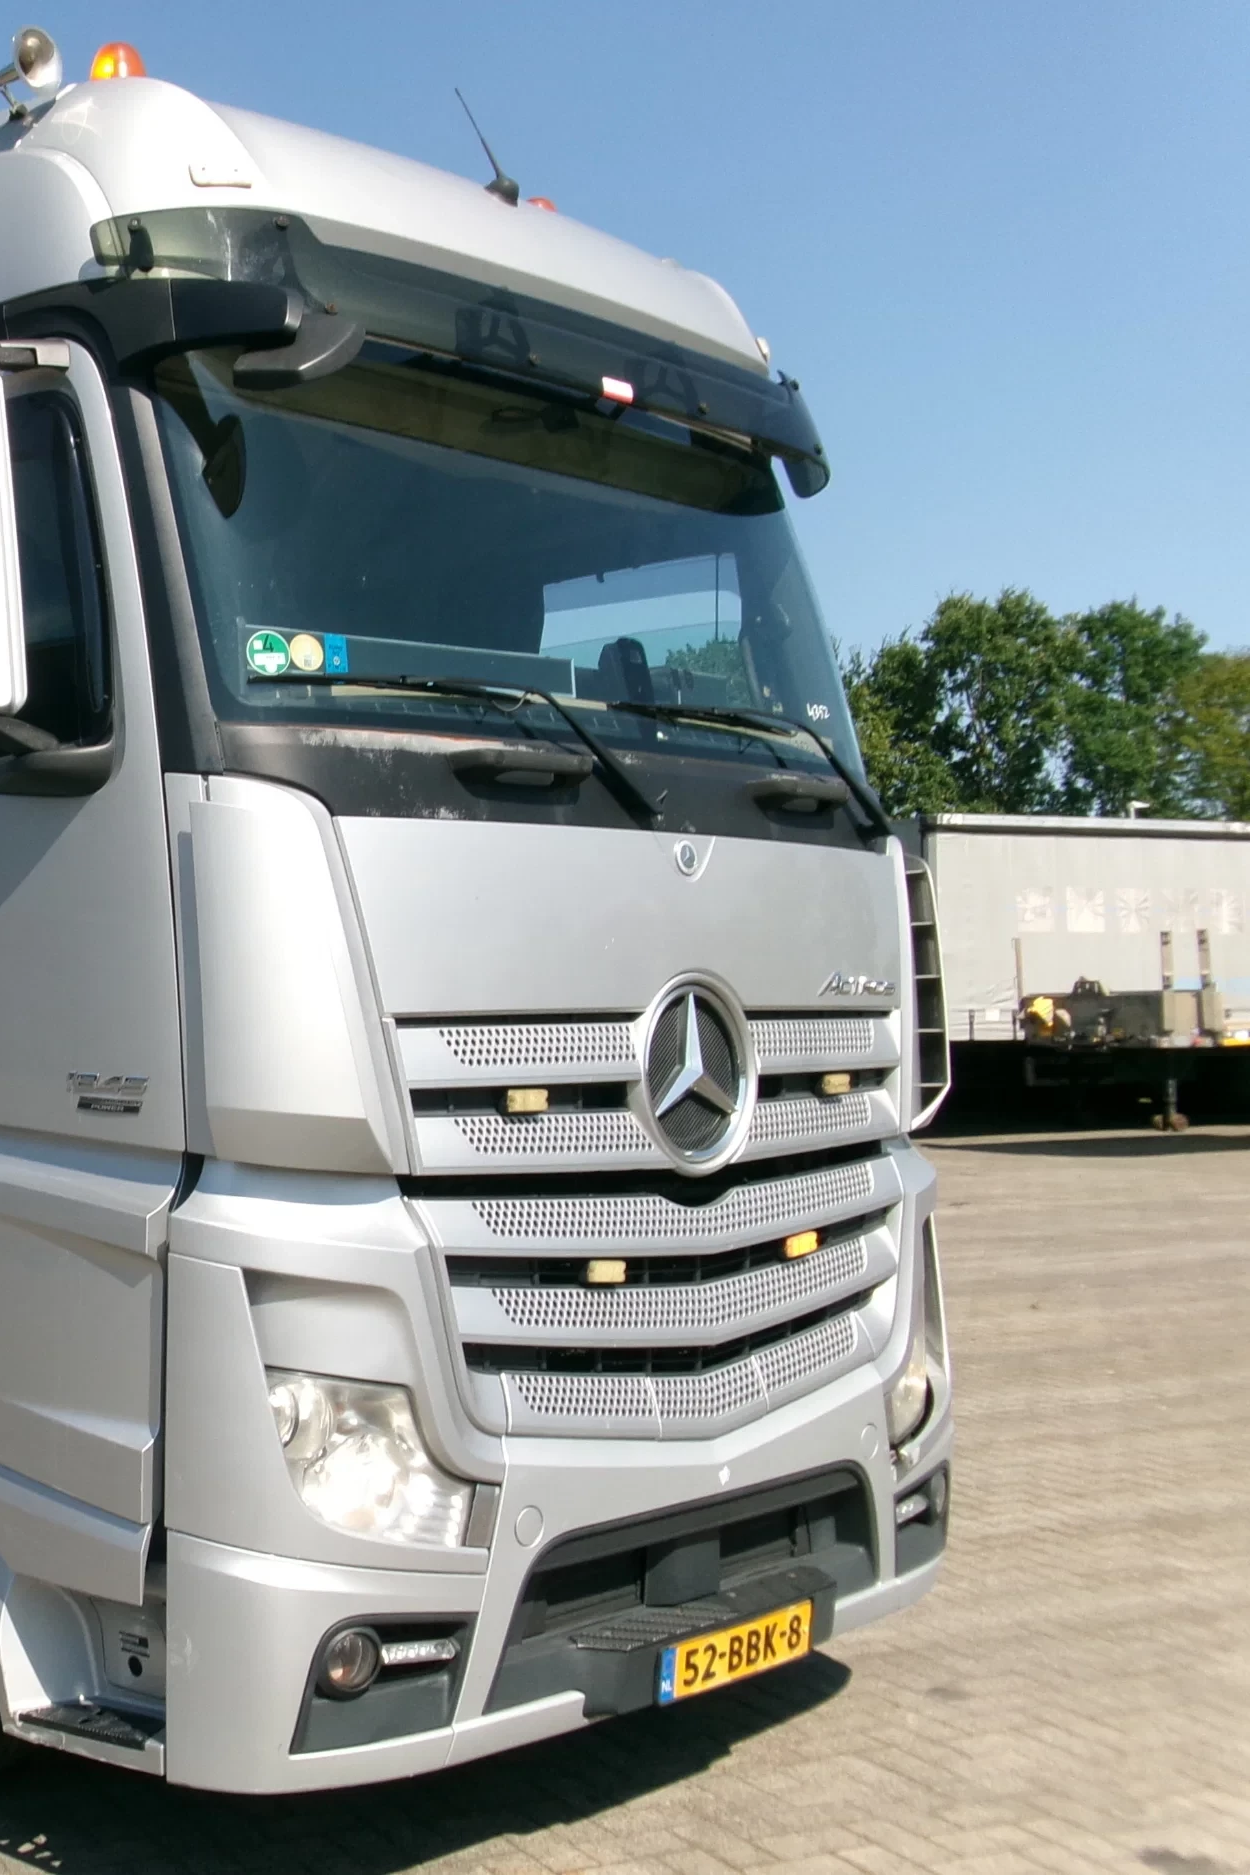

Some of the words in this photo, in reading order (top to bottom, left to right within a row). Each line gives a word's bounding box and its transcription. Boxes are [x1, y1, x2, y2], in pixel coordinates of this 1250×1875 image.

[262, 634, 274, 652] 4
[91, 1103, 124, 1113] POWER
[683, 1615, 801, 1688] 52-BBK-8
[661, 1680, 672, 1693] NL
